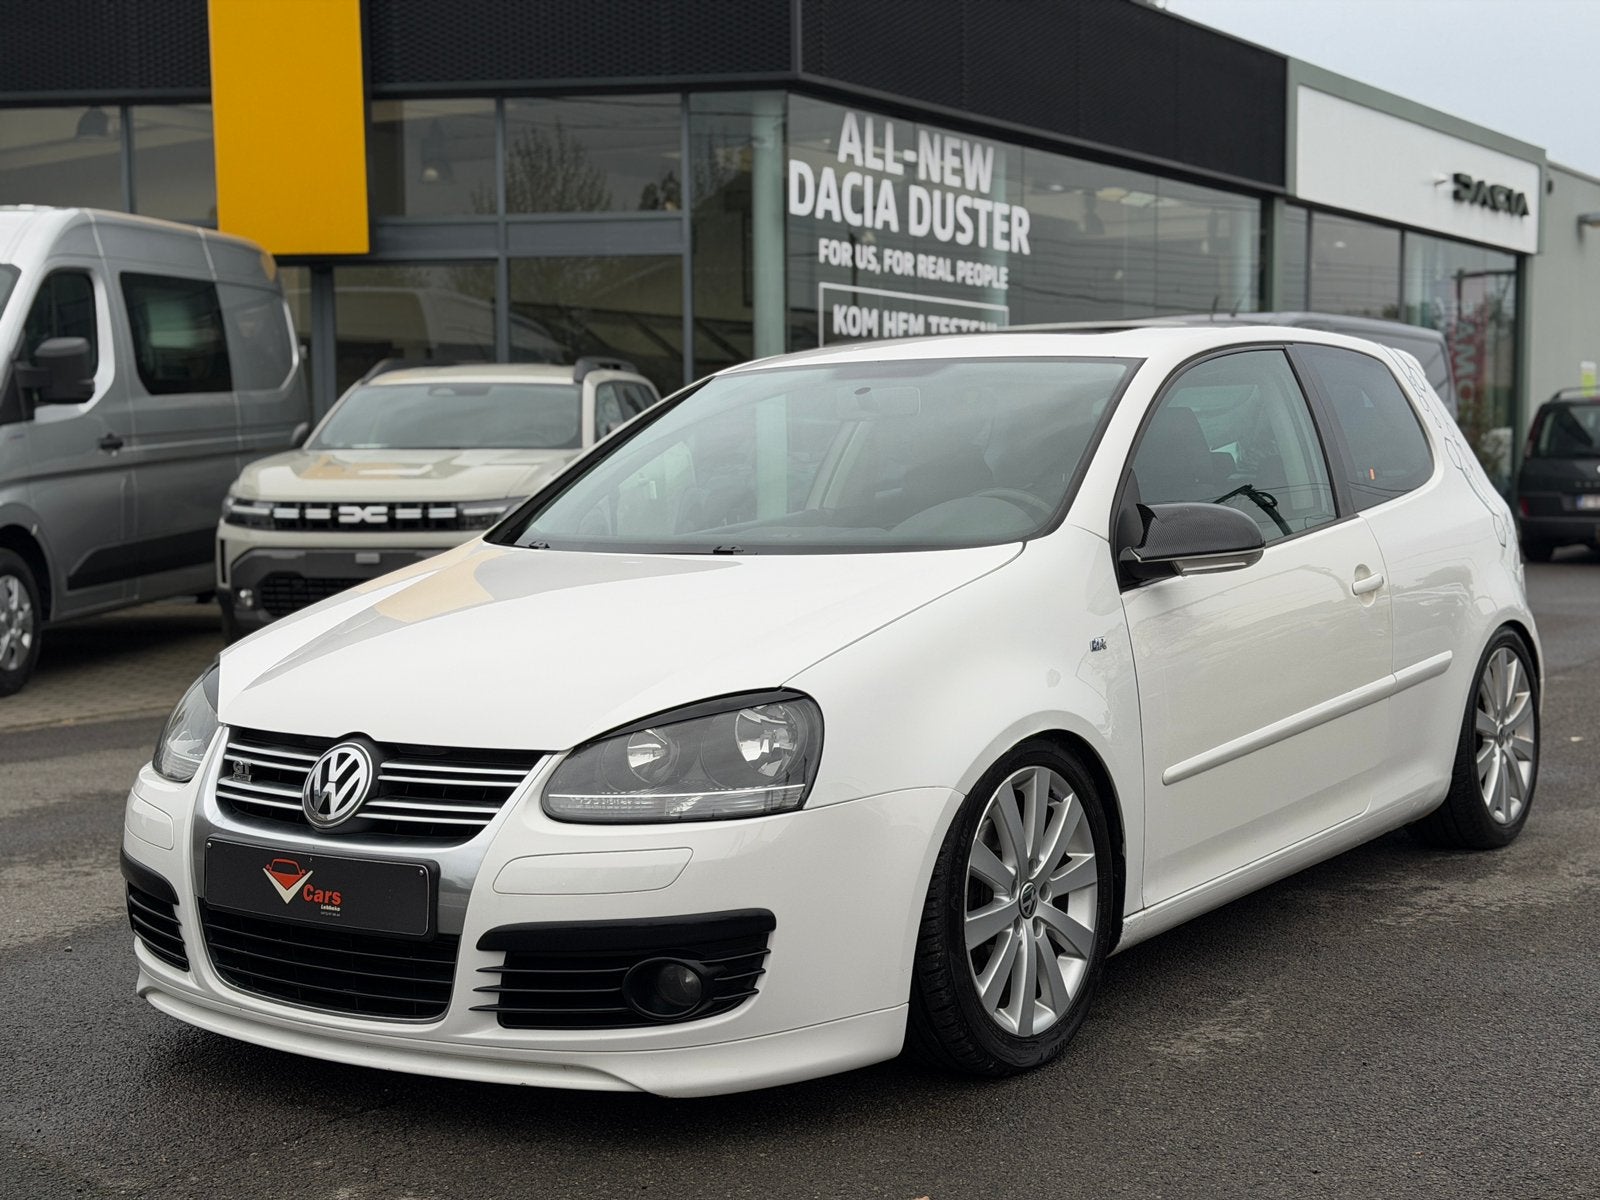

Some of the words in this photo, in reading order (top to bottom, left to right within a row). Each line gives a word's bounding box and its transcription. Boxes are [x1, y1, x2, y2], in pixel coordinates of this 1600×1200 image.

[837, 112, 995, 194] ALL-NEW
[788, 158, 899, 233] DACIA
[908, 184, 1031, 256] DUSTER
[818, 237, 853, 267] FOR
[855, 244, 881, 275] US,
[883, 248, 915, 277] FOR
[916, 253, 955, 283] REAL
[956, 260, 1009, 290] PEOPLE
[832, 303, 879, 338] KOM
[302, 883, 342, 906] Cars
